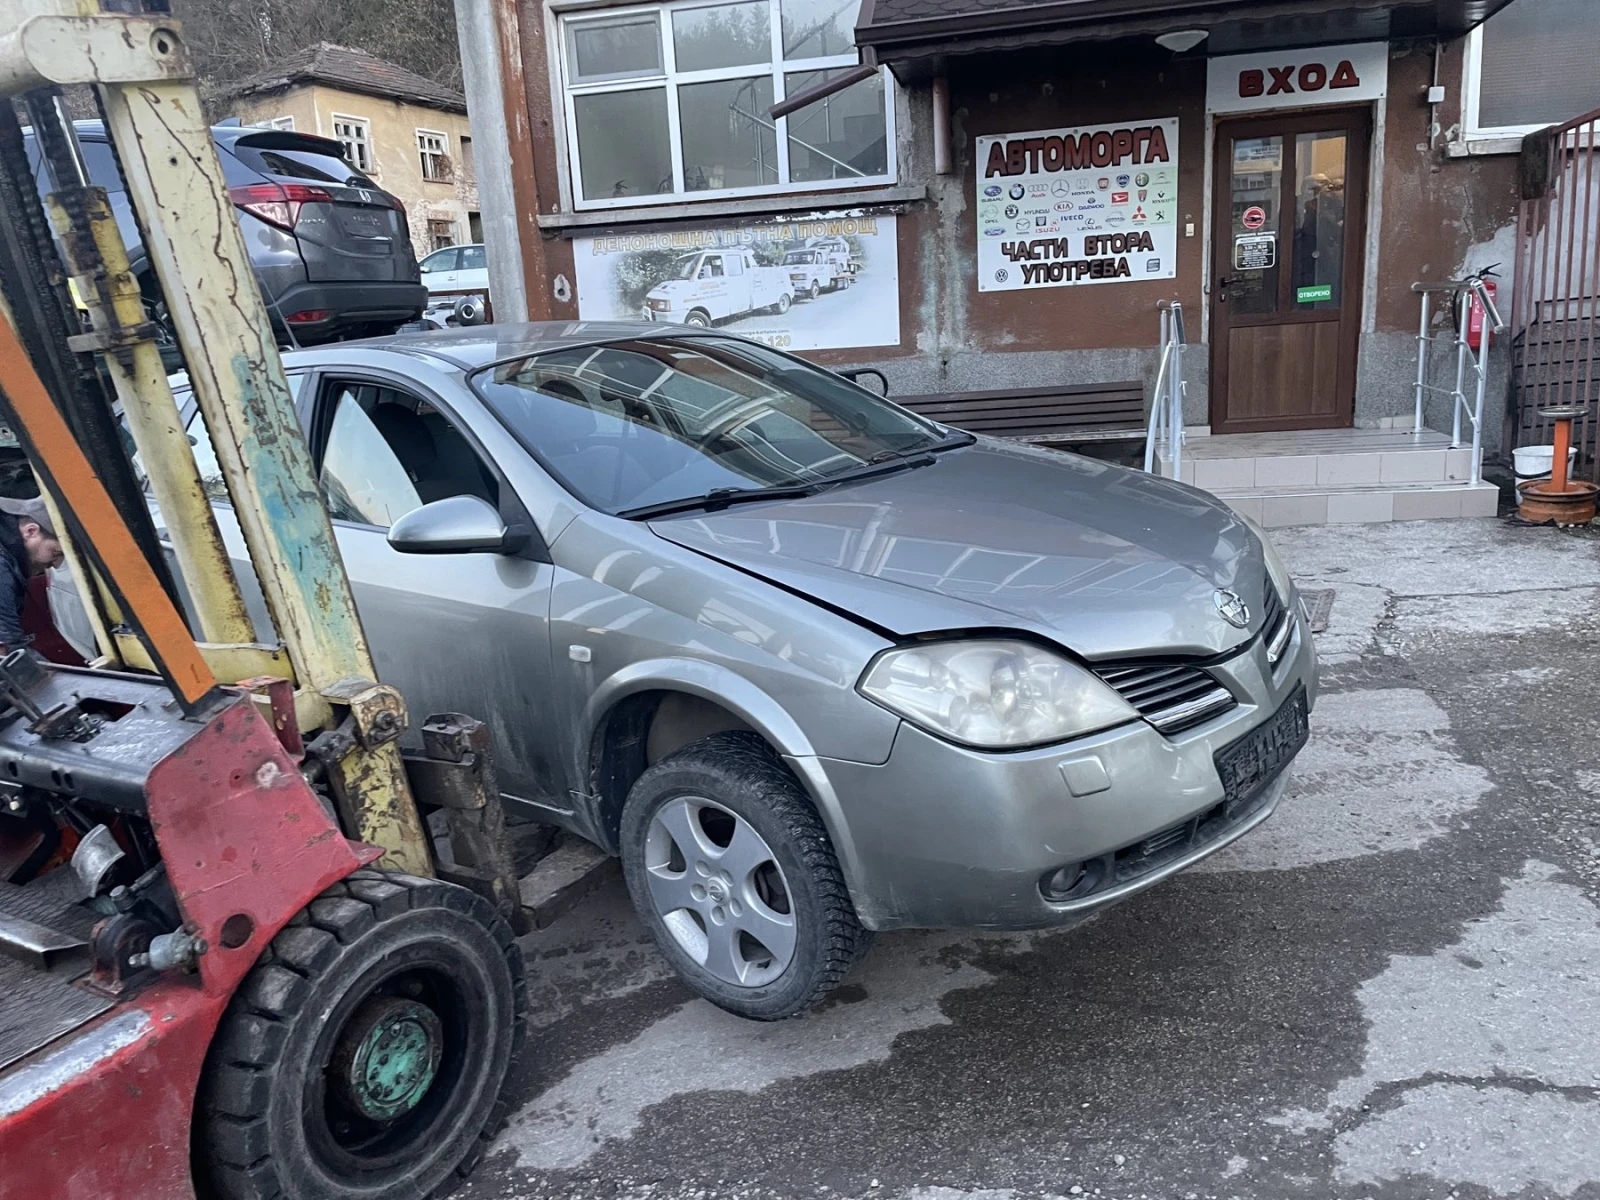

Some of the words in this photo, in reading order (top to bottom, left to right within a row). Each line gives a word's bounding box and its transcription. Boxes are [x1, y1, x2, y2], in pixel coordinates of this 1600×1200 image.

[1239, 60, 1360, 98] ВХОД
[985, 126, 1169, 178] АВТОМОРГА
[1060, 214, 1084, 222] IVECO
[593, 230, 720, 256] ДЕНОНОЩНА
[723, 224, 795, 246] ПЪТНА
[798, 217, 878, 240] ПОМОЩ
[1001, 237, 1068, 262] ЧАСТИ
[1084, 231, 1154, 256] ВТОРА
[1021, 257, 1131, 285] УПОТРЕБА
[1298, 289, 1331, 299] ОТВОРЕНО
